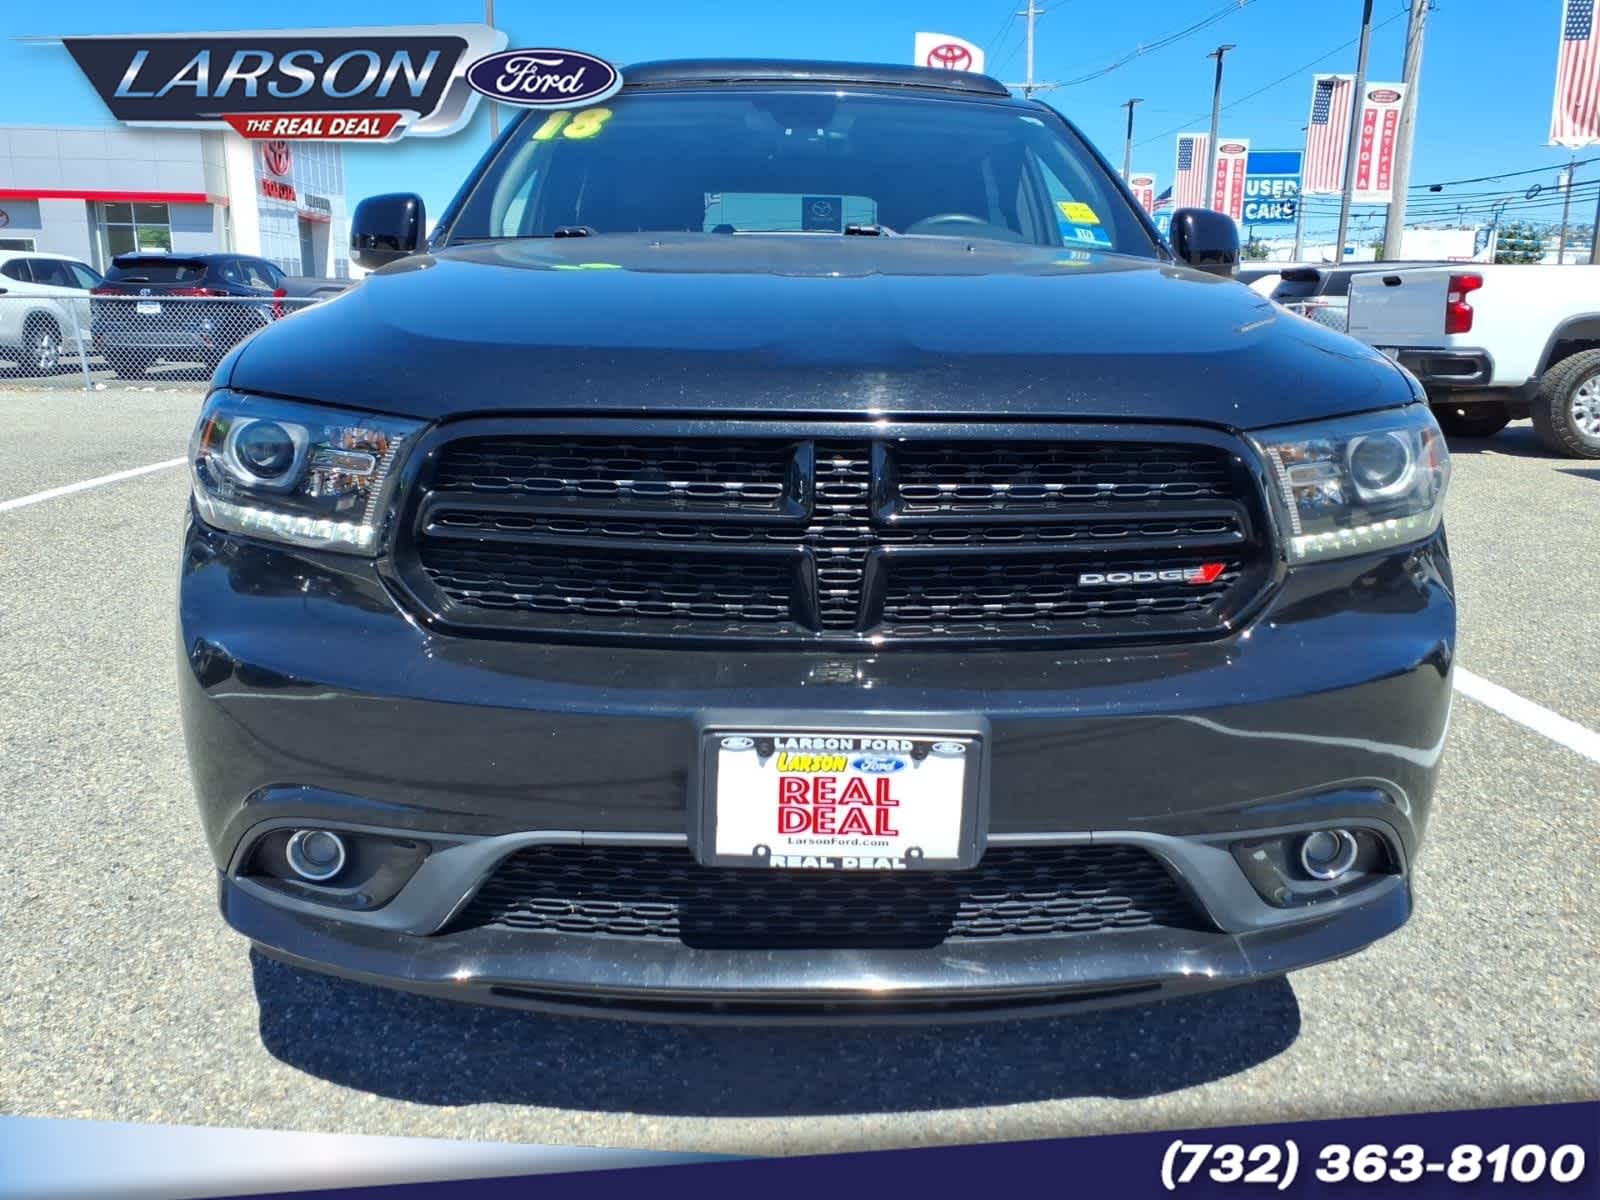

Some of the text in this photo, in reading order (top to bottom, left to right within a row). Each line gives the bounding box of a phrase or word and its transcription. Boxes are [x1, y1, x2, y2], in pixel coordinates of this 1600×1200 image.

[532, 108, 613, 140] 18
[1358, 111, 1375, 187] TOYOTA
[1379, 111, 1396, 189] CERTIFIED
[1215, 160, 1226, 210] TOYOT
[1246, 179, 1298, 196] USED
[1079, 566, 1206, 584] DODGE
[774, 737, 913, 751] LARSON FORD
[776, 752, 847, 773] LARSON
[778, 776, 900, 806] REAL
[777, 806, 899, 836] DEAL
[787, 837, 889, 847] LarsonFord.com
[770, 855, 906, 869] REAL DEAL
